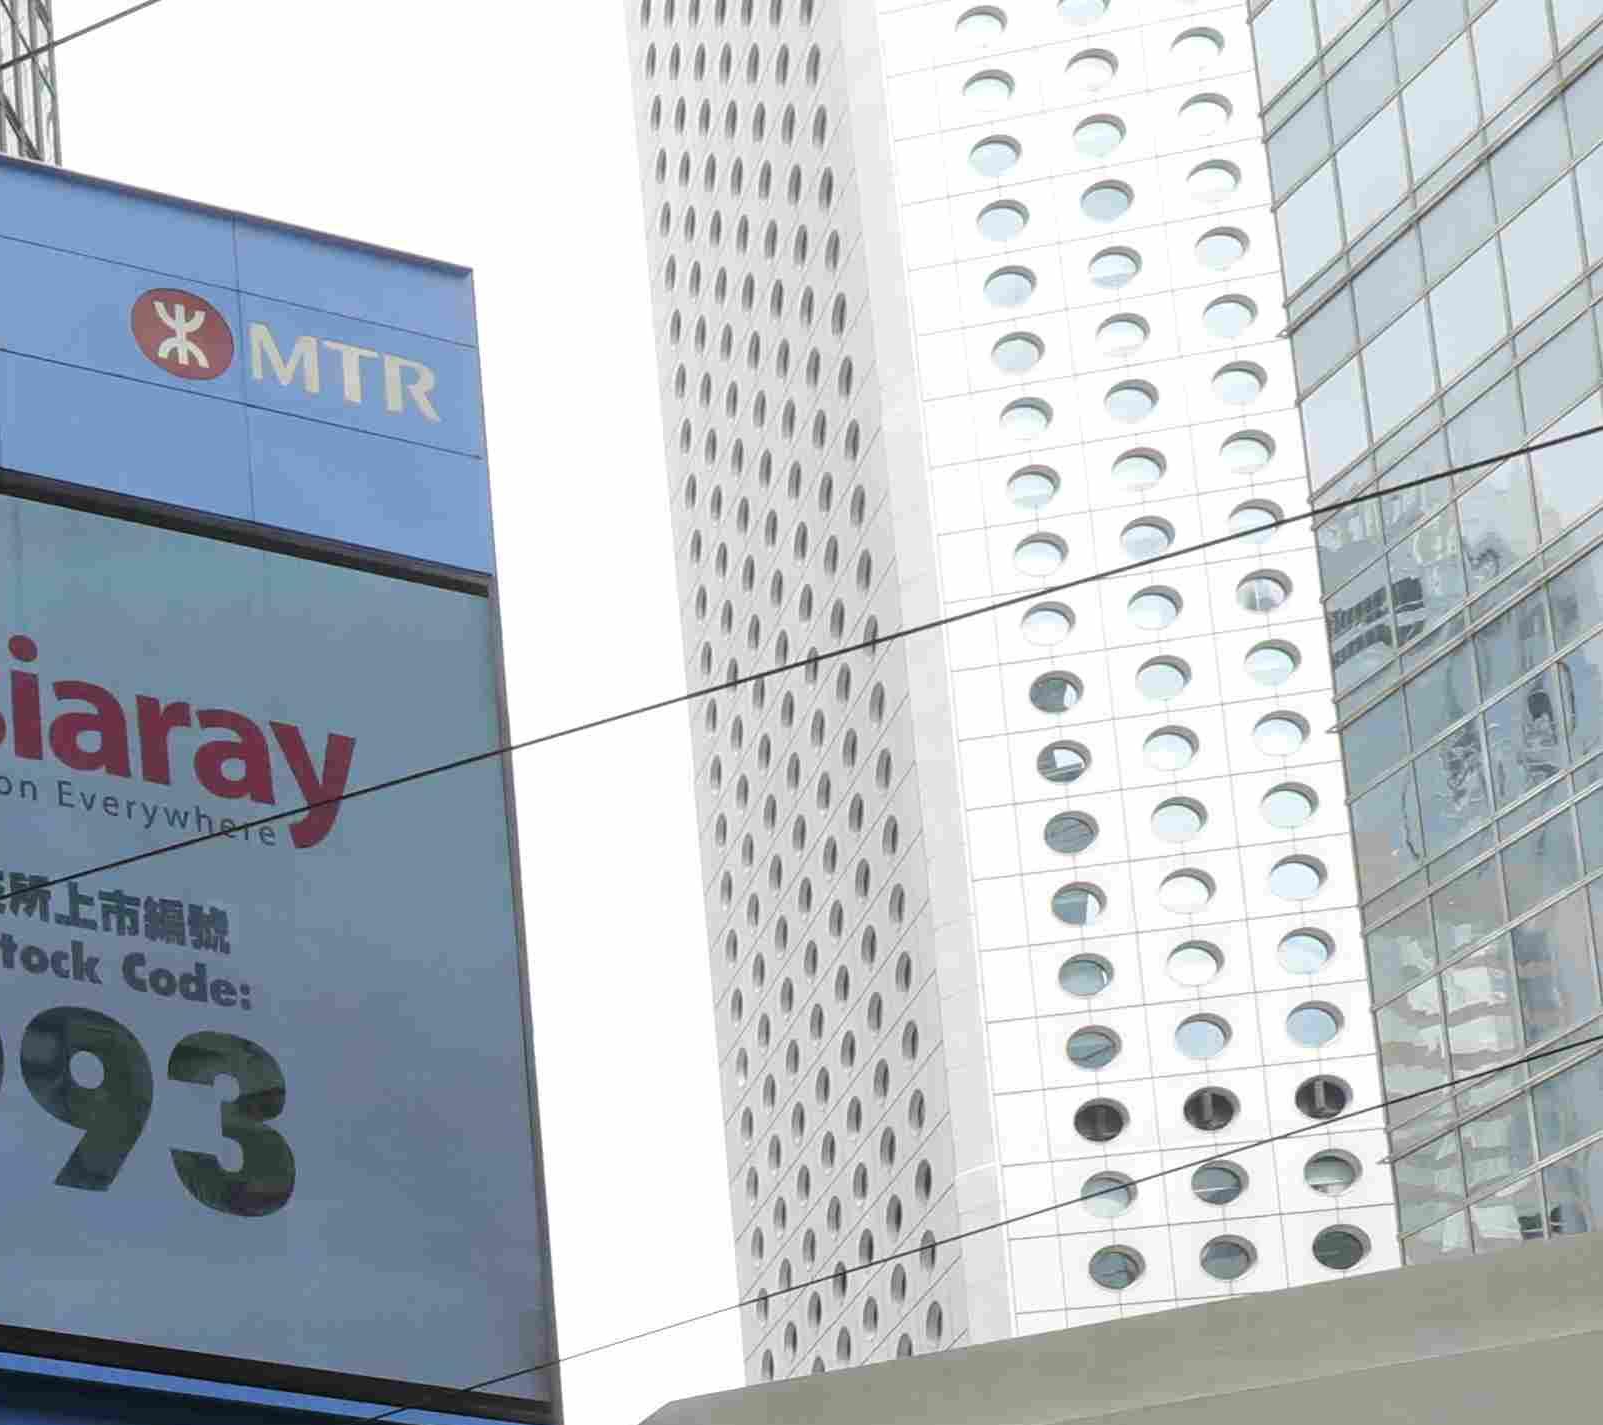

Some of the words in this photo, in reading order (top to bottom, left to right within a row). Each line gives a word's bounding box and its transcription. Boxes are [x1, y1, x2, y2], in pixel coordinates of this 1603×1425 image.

[249, 322, 441, 423] MTR
[56, 777, 279, 848] Everywhere
[122, 953, 254, 1010] Code:
